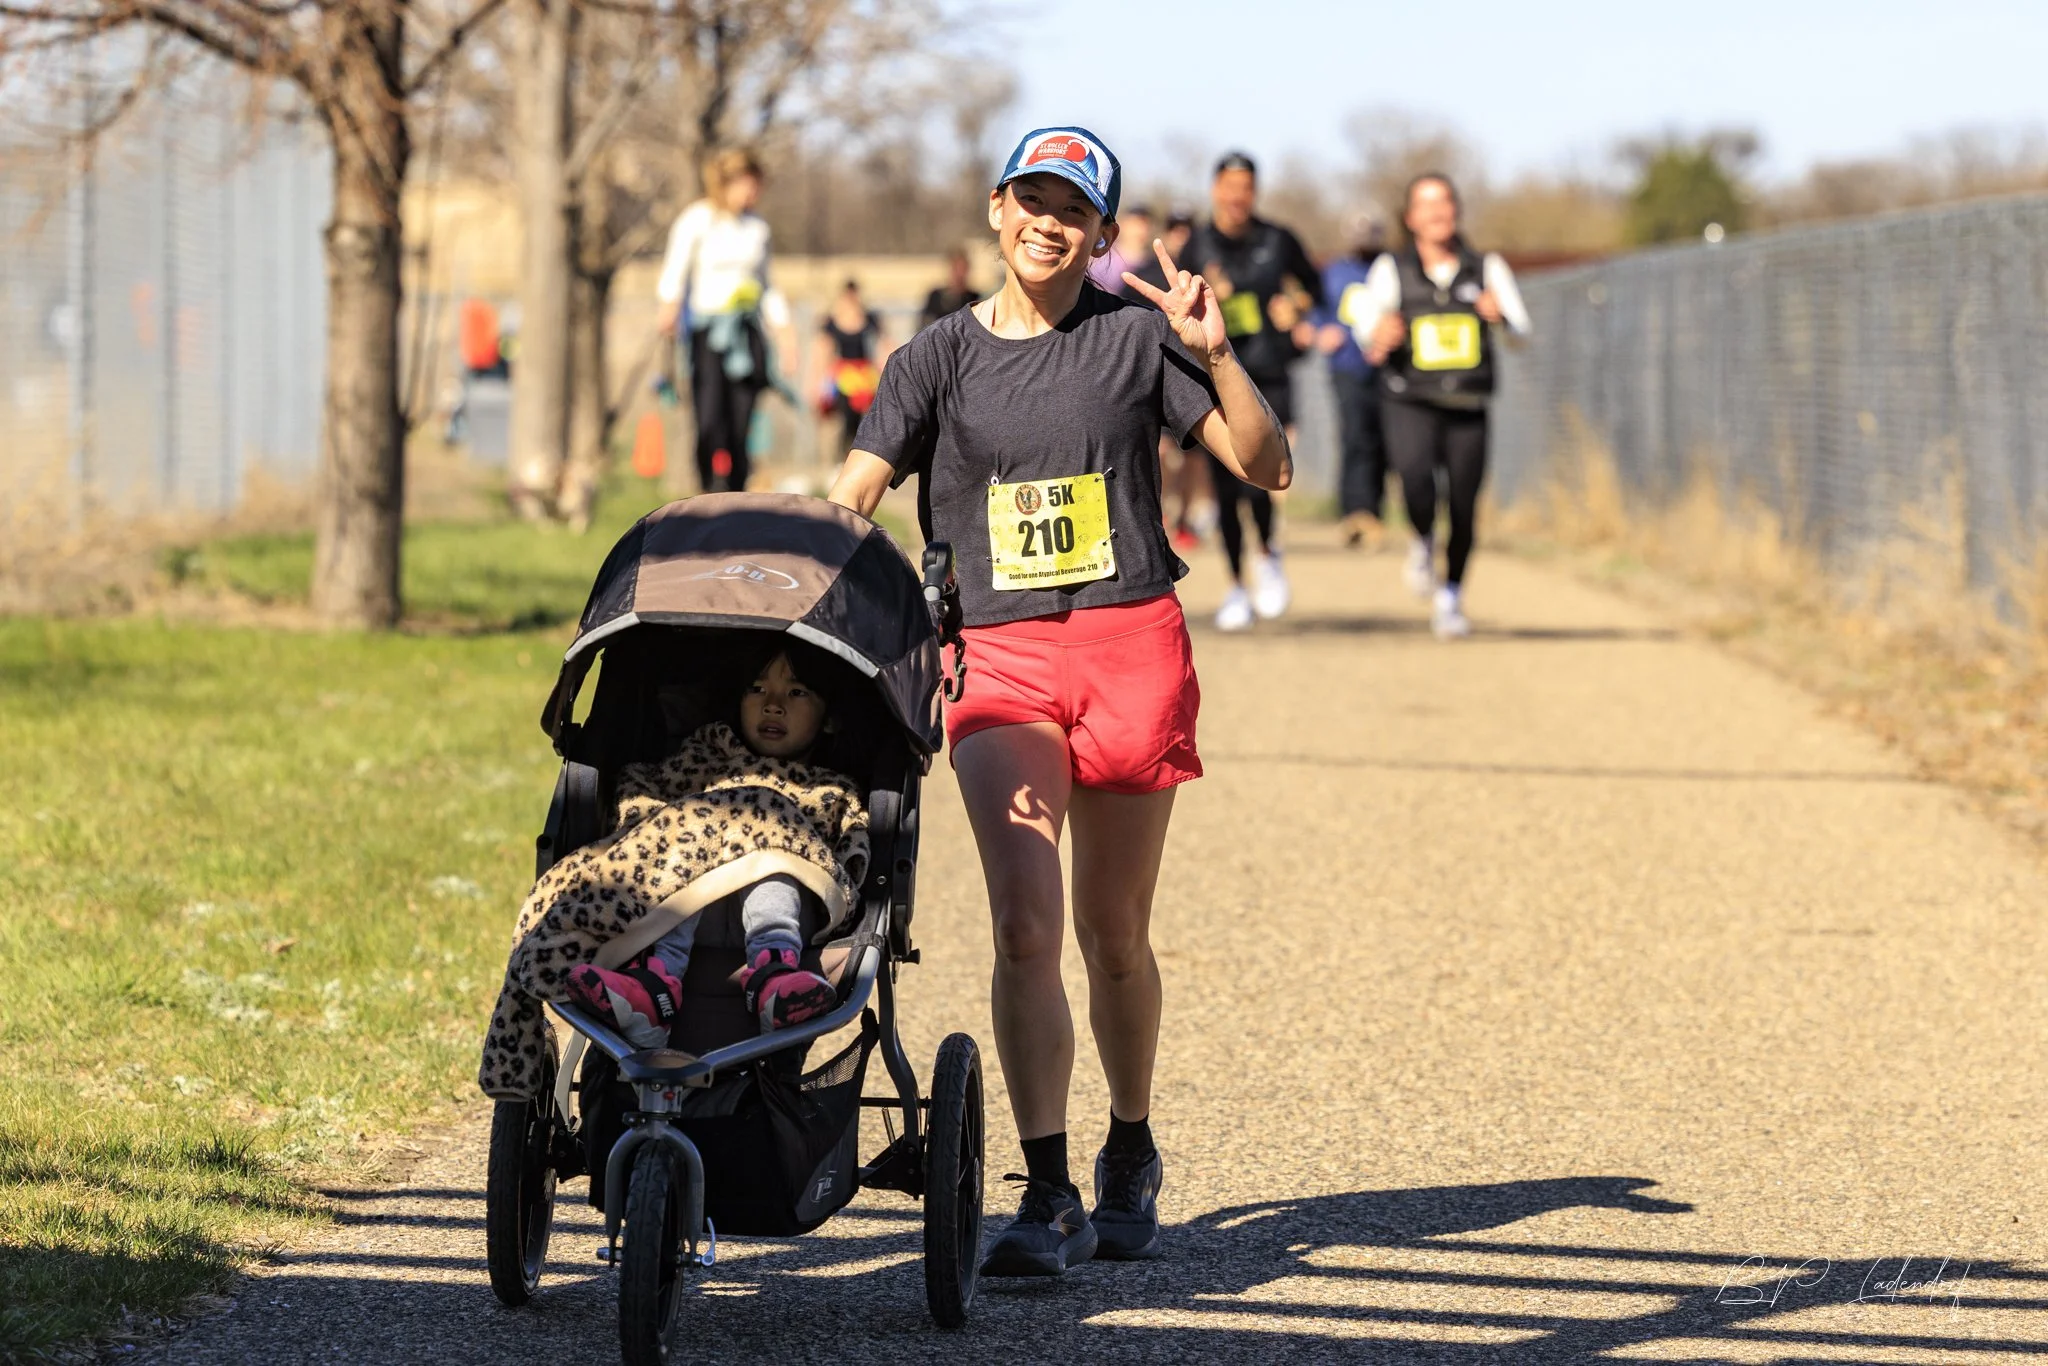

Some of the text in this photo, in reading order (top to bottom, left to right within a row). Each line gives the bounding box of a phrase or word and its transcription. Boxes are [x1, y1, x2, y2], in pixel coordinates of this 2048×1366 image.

[1047, 484, 1075, 507] 5K
[1018, 516, 1075, 557] 210
[1038, 569, 1060, 578] Atypical
[1060, 566, 1086, 575] Beverage
[1087, 563, 1098, 571] 210
[656, 992, 675, 1018] NIKE
